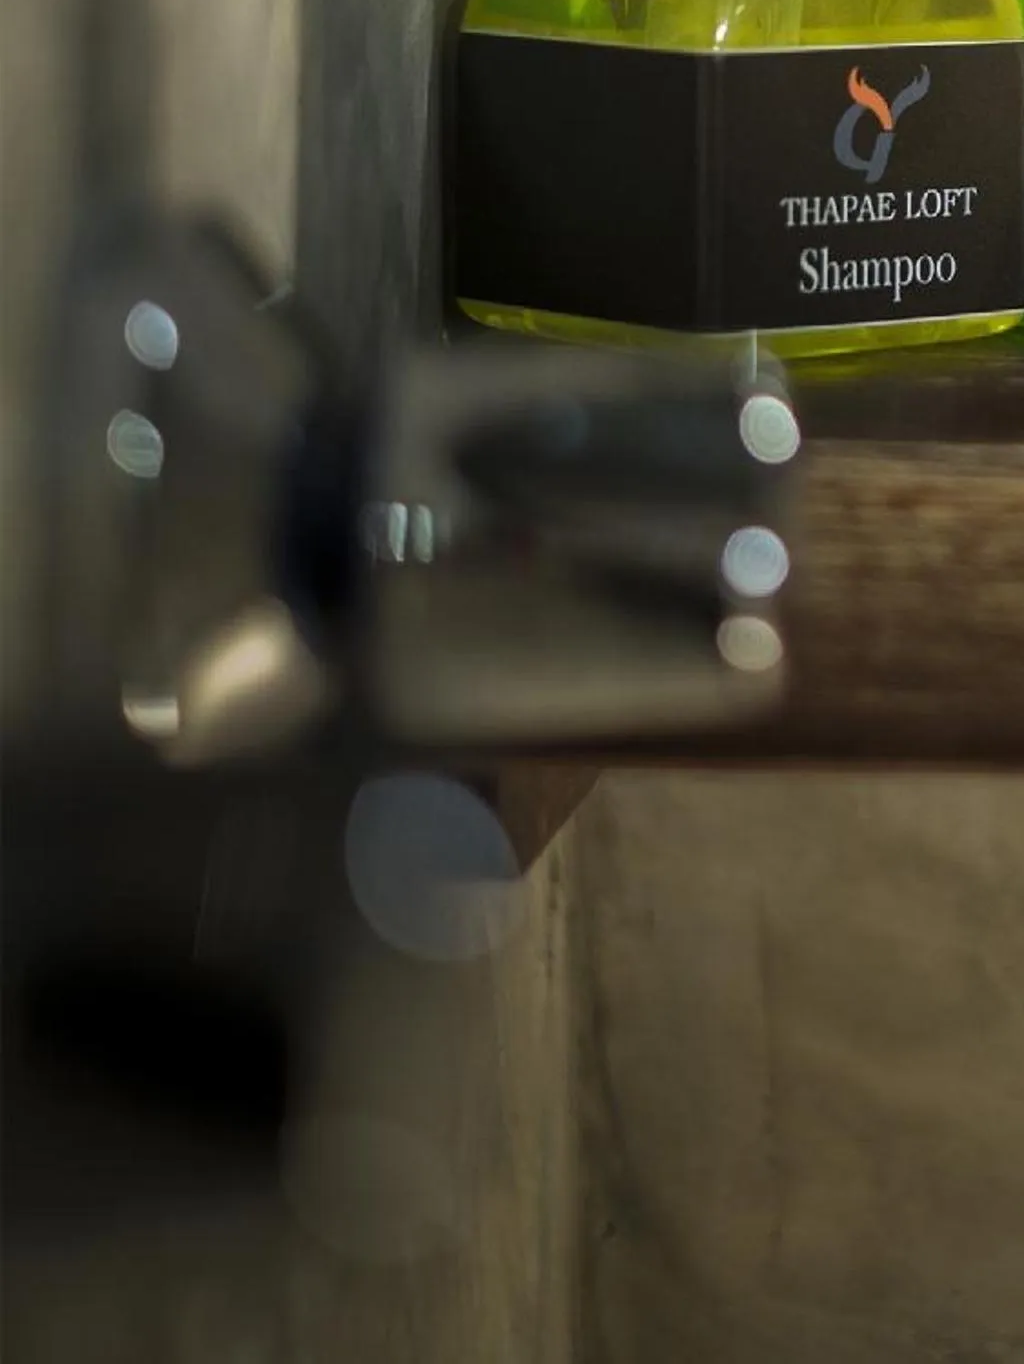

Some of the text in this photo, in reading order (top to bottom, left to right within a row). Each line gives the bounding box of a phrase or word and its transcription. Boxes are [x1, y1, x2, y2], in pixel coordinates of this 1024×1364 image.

[780, 187, 978, 227] THAPAE LOFT
[799, 246, 957, 303] Shampoo
